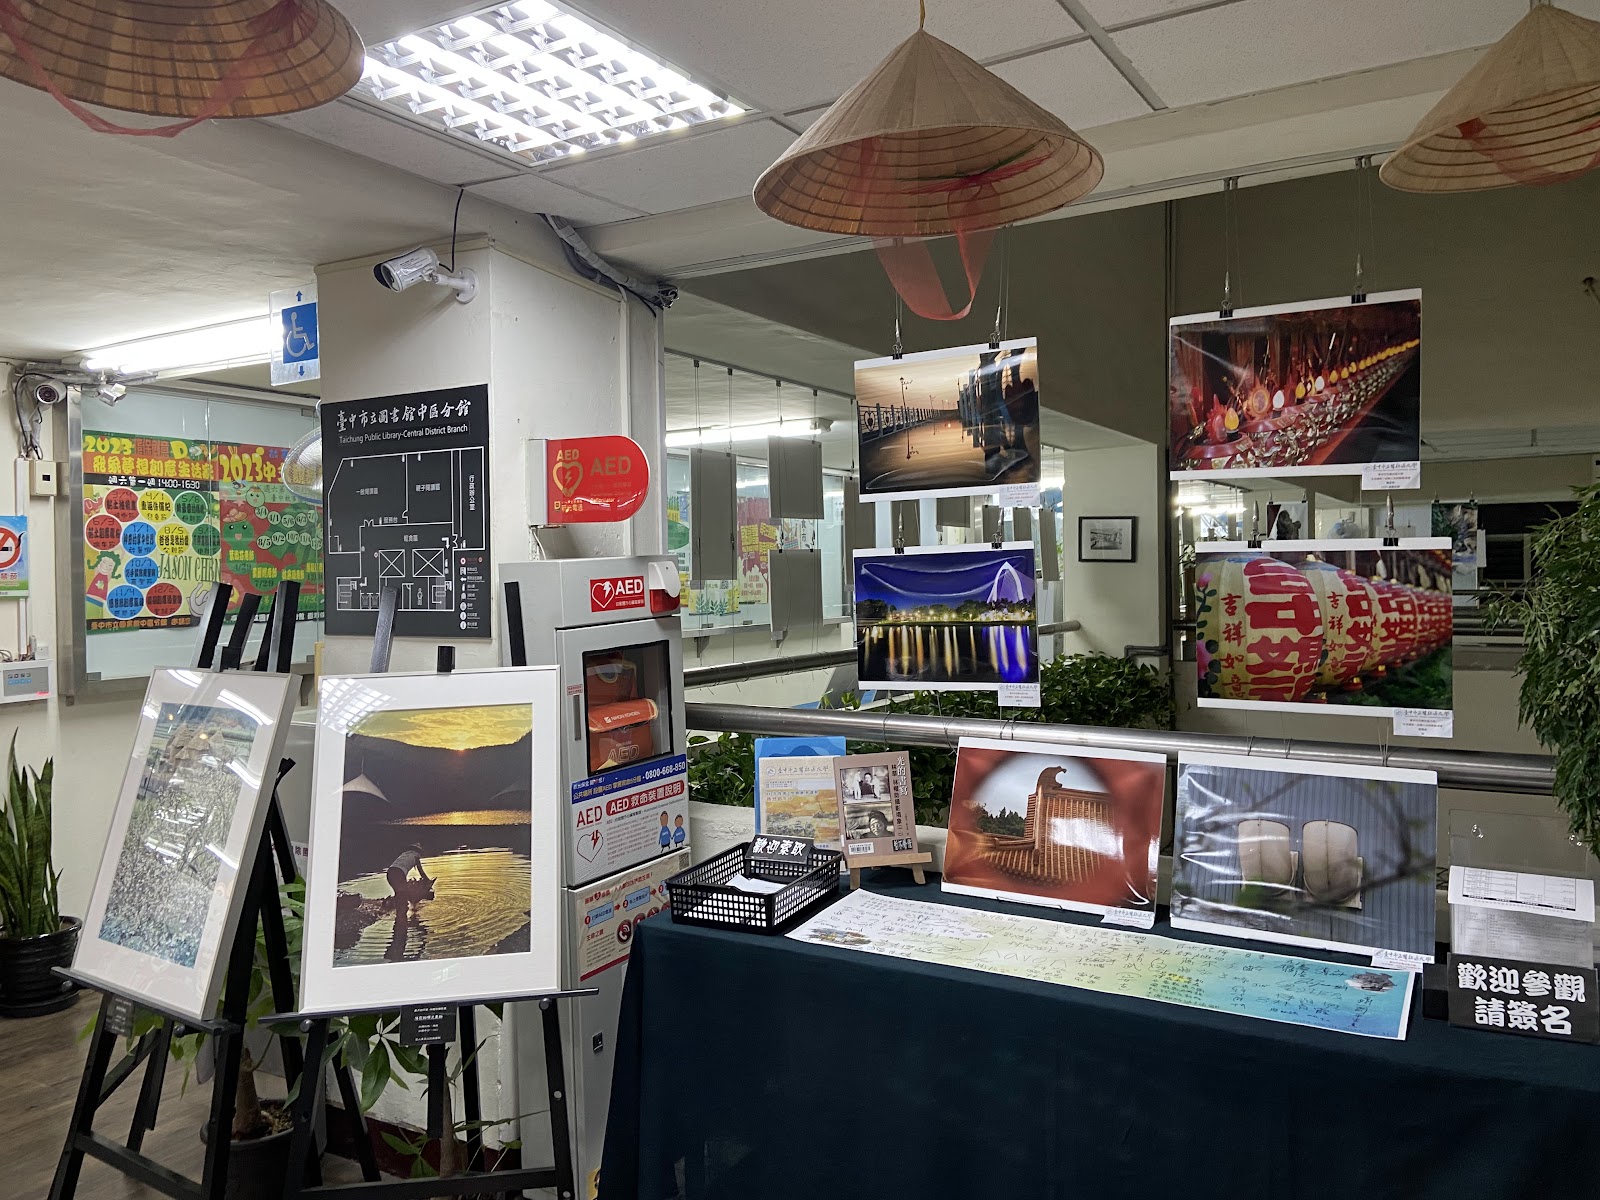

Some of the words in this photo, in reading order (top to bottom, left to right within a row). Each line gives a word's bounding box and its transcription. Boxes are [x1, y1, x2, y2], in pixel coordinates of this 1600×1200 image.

[339, 435, 364, 444] Taichung
[364, 432, 381, 442] Public
[382, 428, 423, 441] Library-Central
[424, 426, 446, 436] District
[446, 423, 468, 433] Branch
[84, 435, 133, 456] 2023
[556, 448, 580, 462] AED
[589, 455, 632, 477] AED
[614, 579, 644, 596] AED
[1219, 592, 1251, 699] 吉祥如意
[576, 805, 603, 828] AED
[609, 798, 629, 815] AED
[752, 837, 807, 857] 歡迎索取
[1456, 962, 1586, 1003] 歡迎參觀
[1474, 995, 1573, 1036] 請簽名
